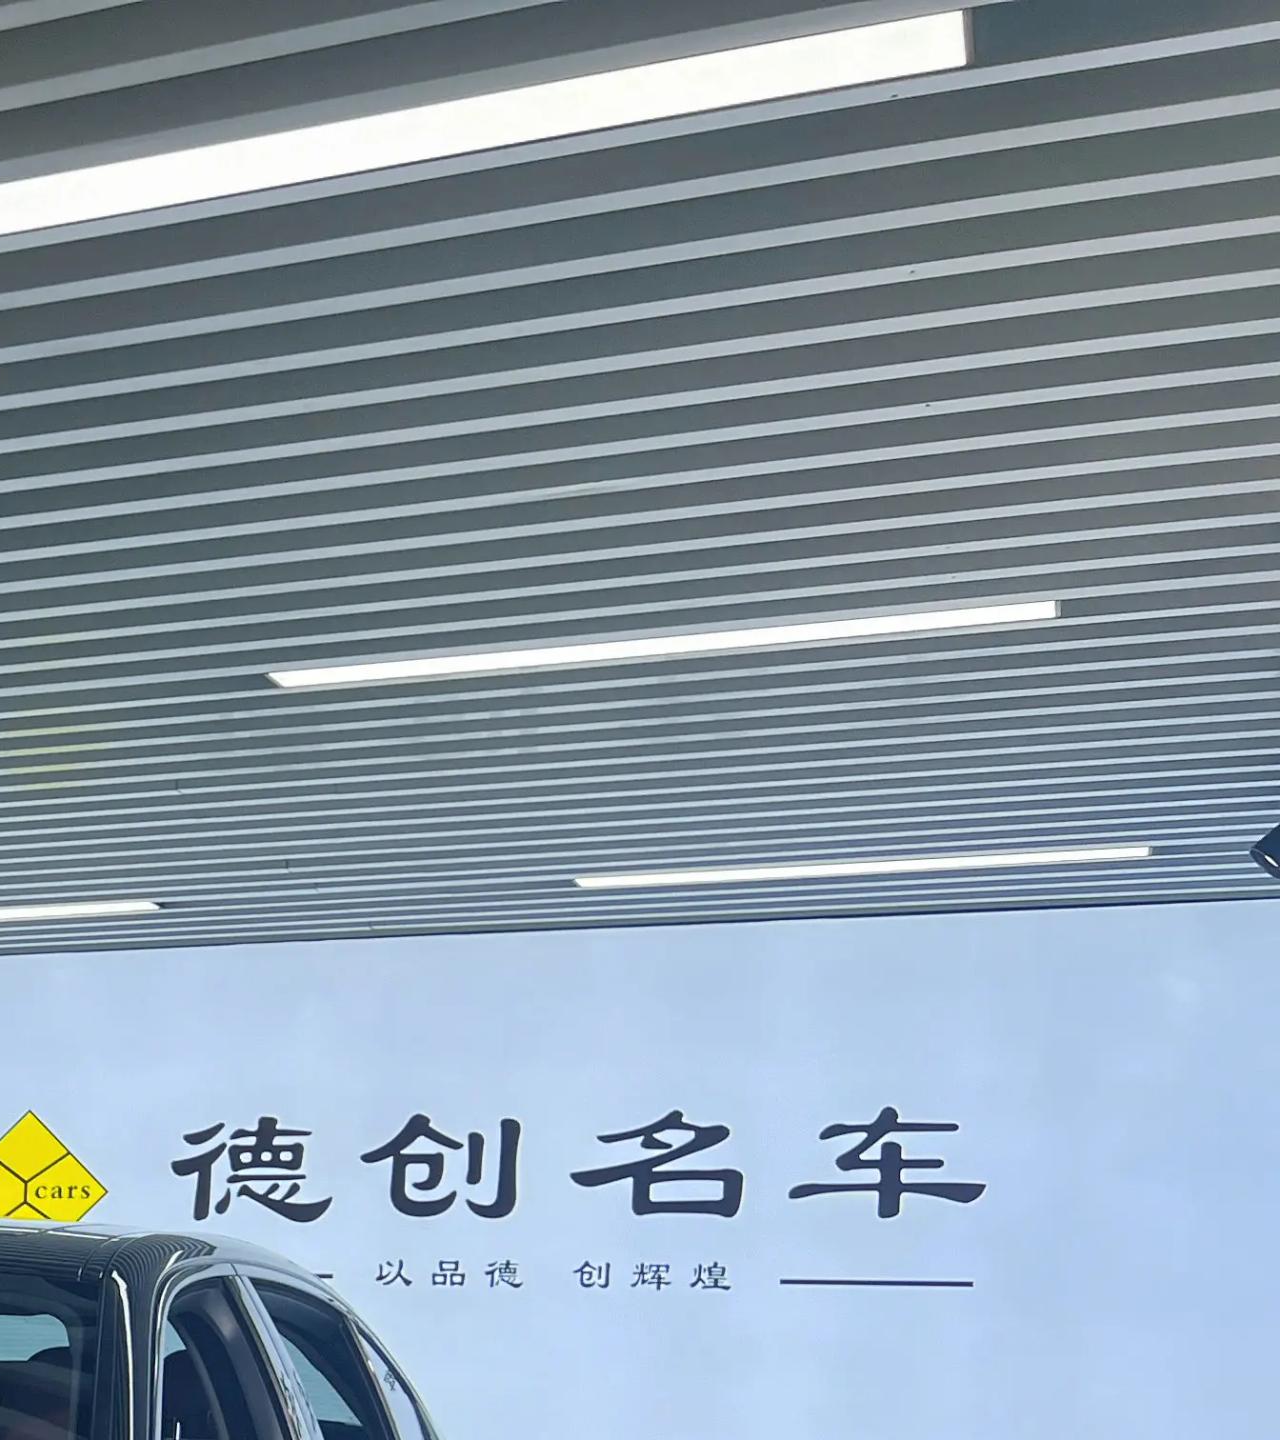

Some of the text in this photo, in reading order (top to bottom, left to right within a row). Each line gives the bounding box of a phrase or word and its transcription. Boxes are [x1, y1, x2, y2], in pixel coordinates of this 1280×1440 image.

[170, 1107, 987, 1223] 德创名车
[36, 1184, 90, 1200] cars
[374, 1259, 735, 1291] 以品德 创辉煌
